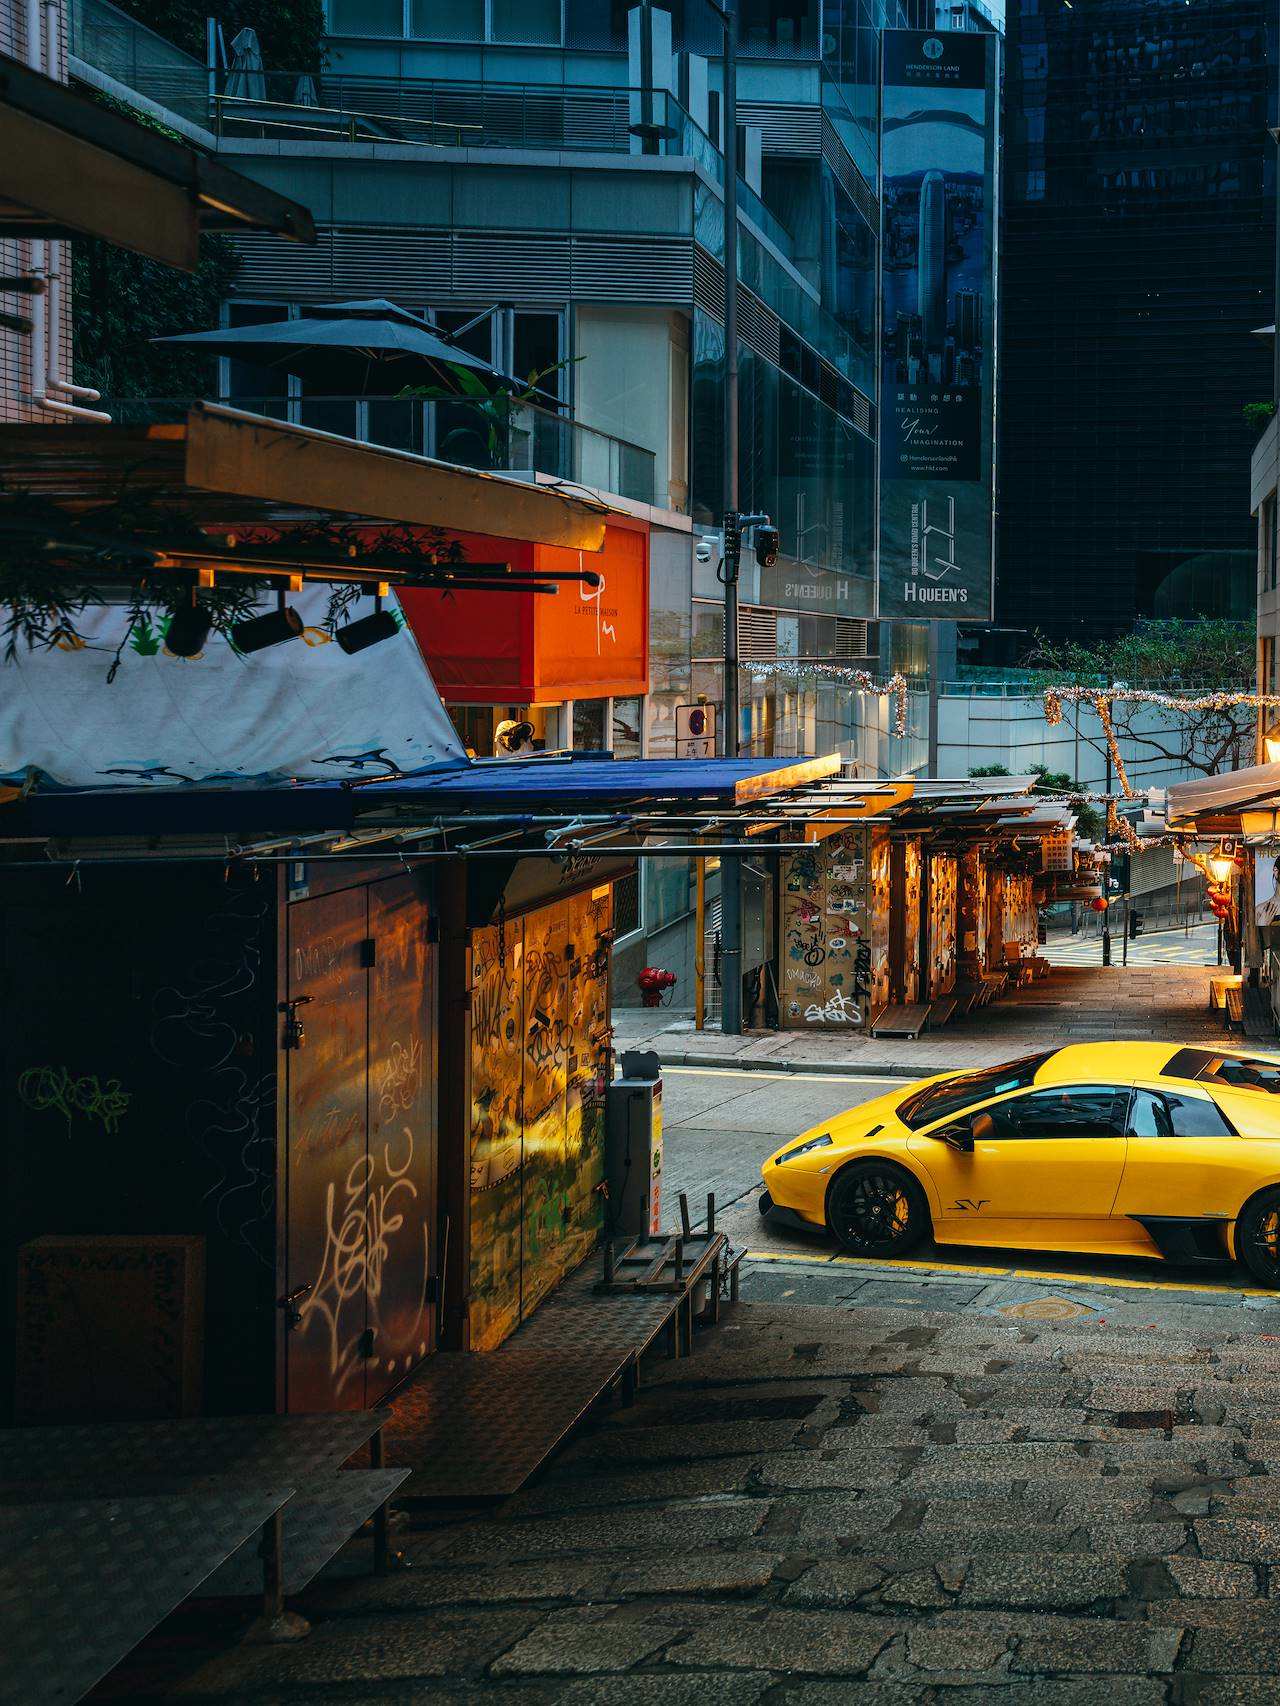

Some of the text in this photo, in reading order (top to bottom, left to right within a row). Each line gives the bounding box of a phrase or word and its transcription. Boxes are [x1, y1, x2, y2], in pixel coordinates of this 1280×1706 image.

[901, 416, 939, 442] Your
[903, 582, 968, 603] H QUEEN'S
[574, 605, 618, 617] LA PETITE MAISON
[703, 741, 709, 755] 7
